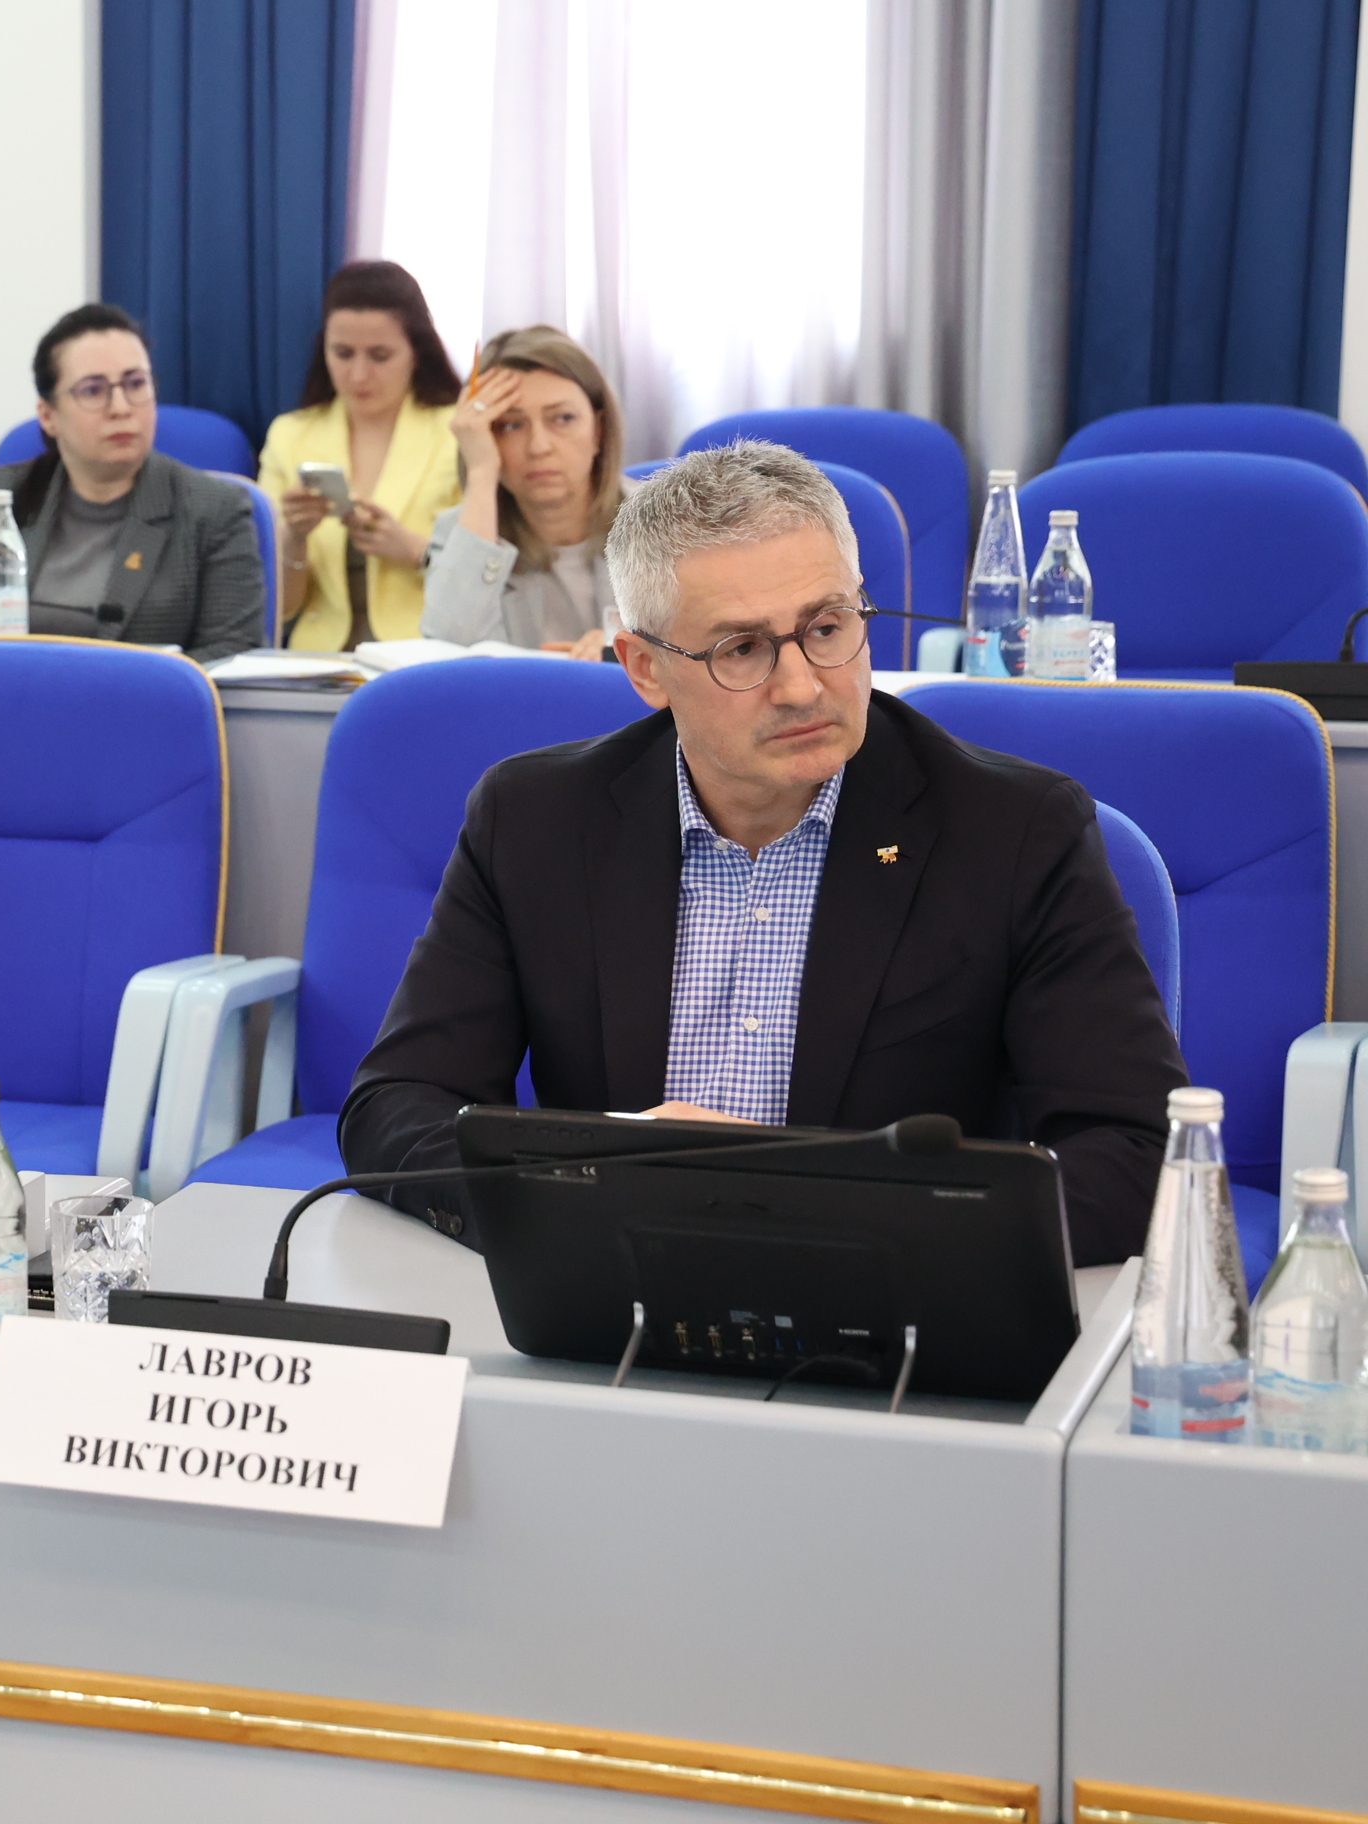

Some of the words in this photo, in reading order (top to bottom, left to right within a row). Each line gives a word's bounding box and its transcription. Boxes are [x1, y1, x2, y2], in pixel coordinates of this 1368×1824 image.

[139, 1342, 312, 1386] ЛАВРОВ
[147, 1392, 289, 1435] ИГОРЬ
[62, 1434, 360, 1493] ВИКТОРОВИЧ
